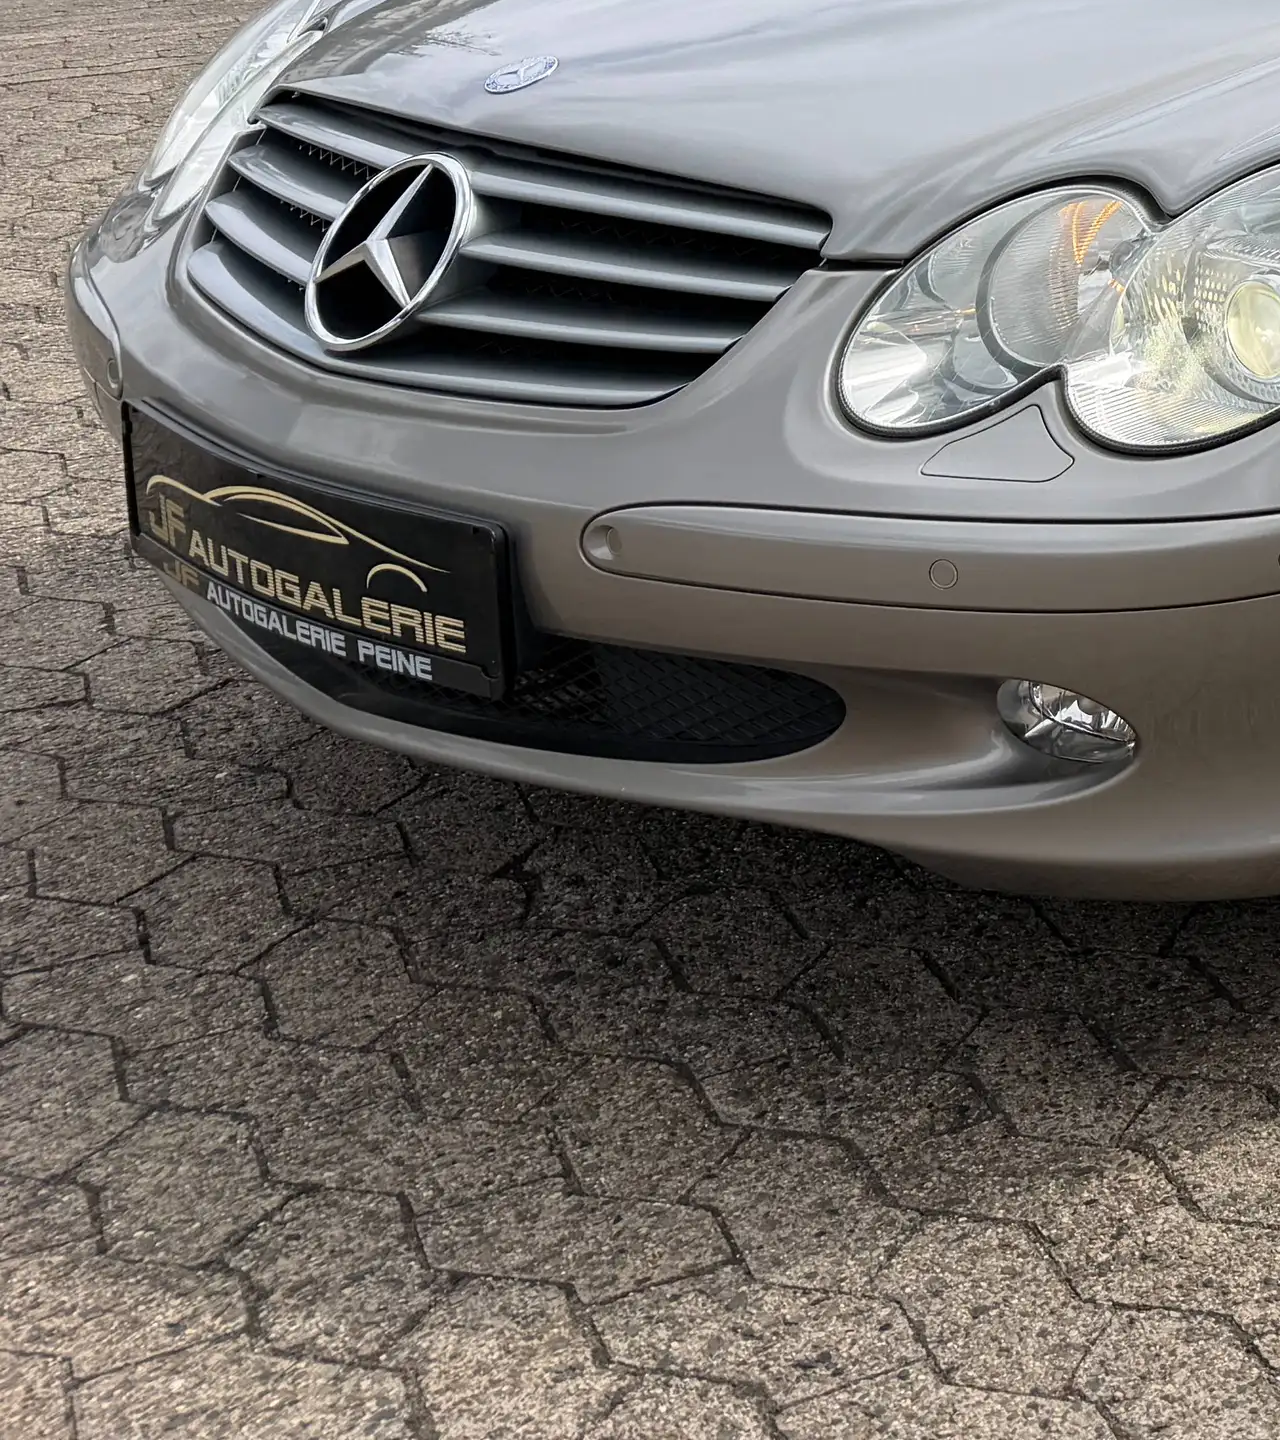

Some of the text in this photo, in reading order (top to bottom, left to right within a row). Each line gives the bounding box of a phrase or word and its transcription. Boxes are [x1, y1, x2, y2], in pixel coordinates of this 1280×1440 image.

[188, 529, 467, 653] AUTOGALERIE
[207, 581, 346, 656] AUTOGALERIE
[358, 638, 433, 681] PEINE
